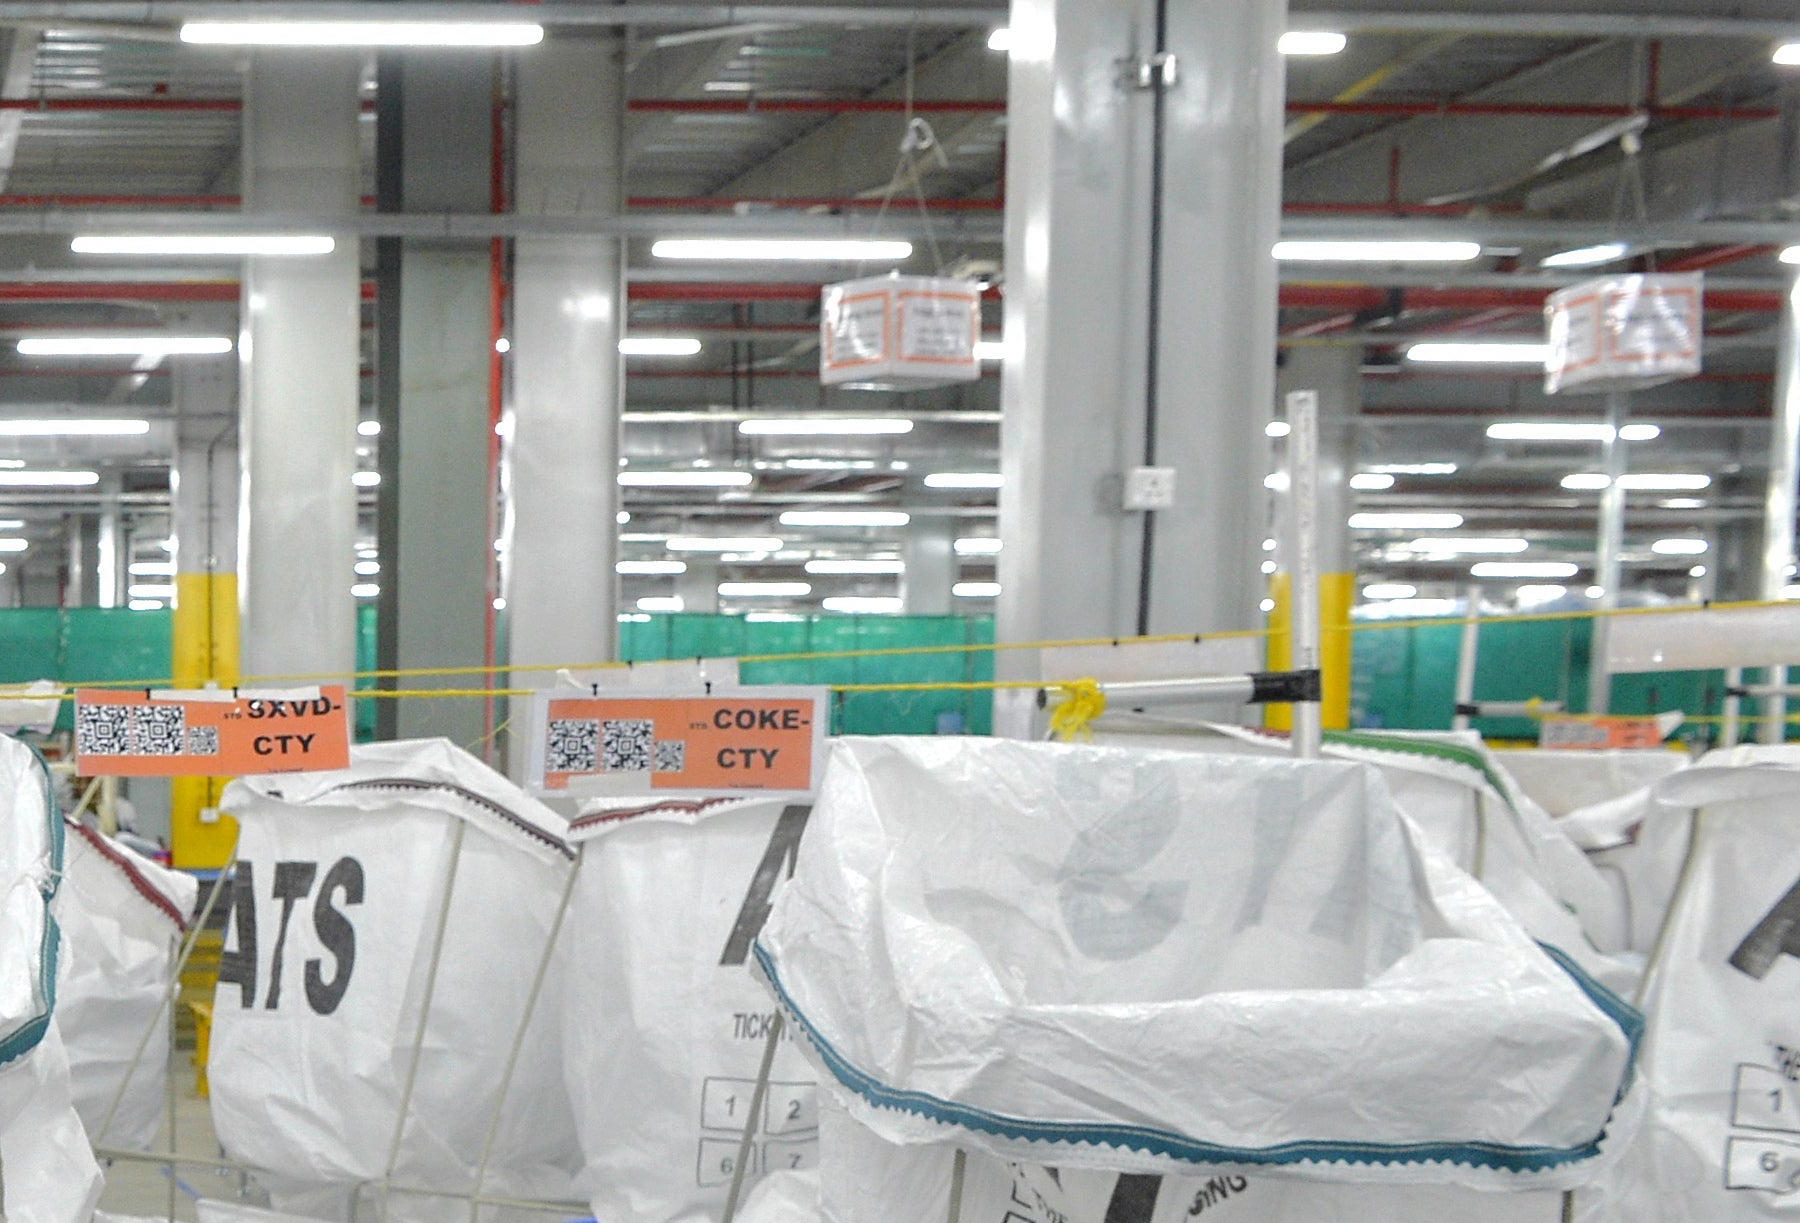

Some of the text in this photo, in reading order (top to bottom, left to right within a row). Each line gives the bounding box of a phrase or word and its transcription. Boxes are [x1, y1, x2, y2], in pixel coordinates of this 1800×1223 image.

[248, 696, 341, 719] SXVD-
[714, 708, 810, 730] COKE-
[253, 733, 316, 756] CTY
[717, 748, 780, 769] CTY
[725, 1094, 737, 1117] 1
[788, 1099, 801, 1120] 2
[1769, 1088, 1782, 1112] 1
[720, 1157, 734, 1175] 6
[790, 1154, 804, 1170] 7
[1759, 1150, 1779, 1173] 6
